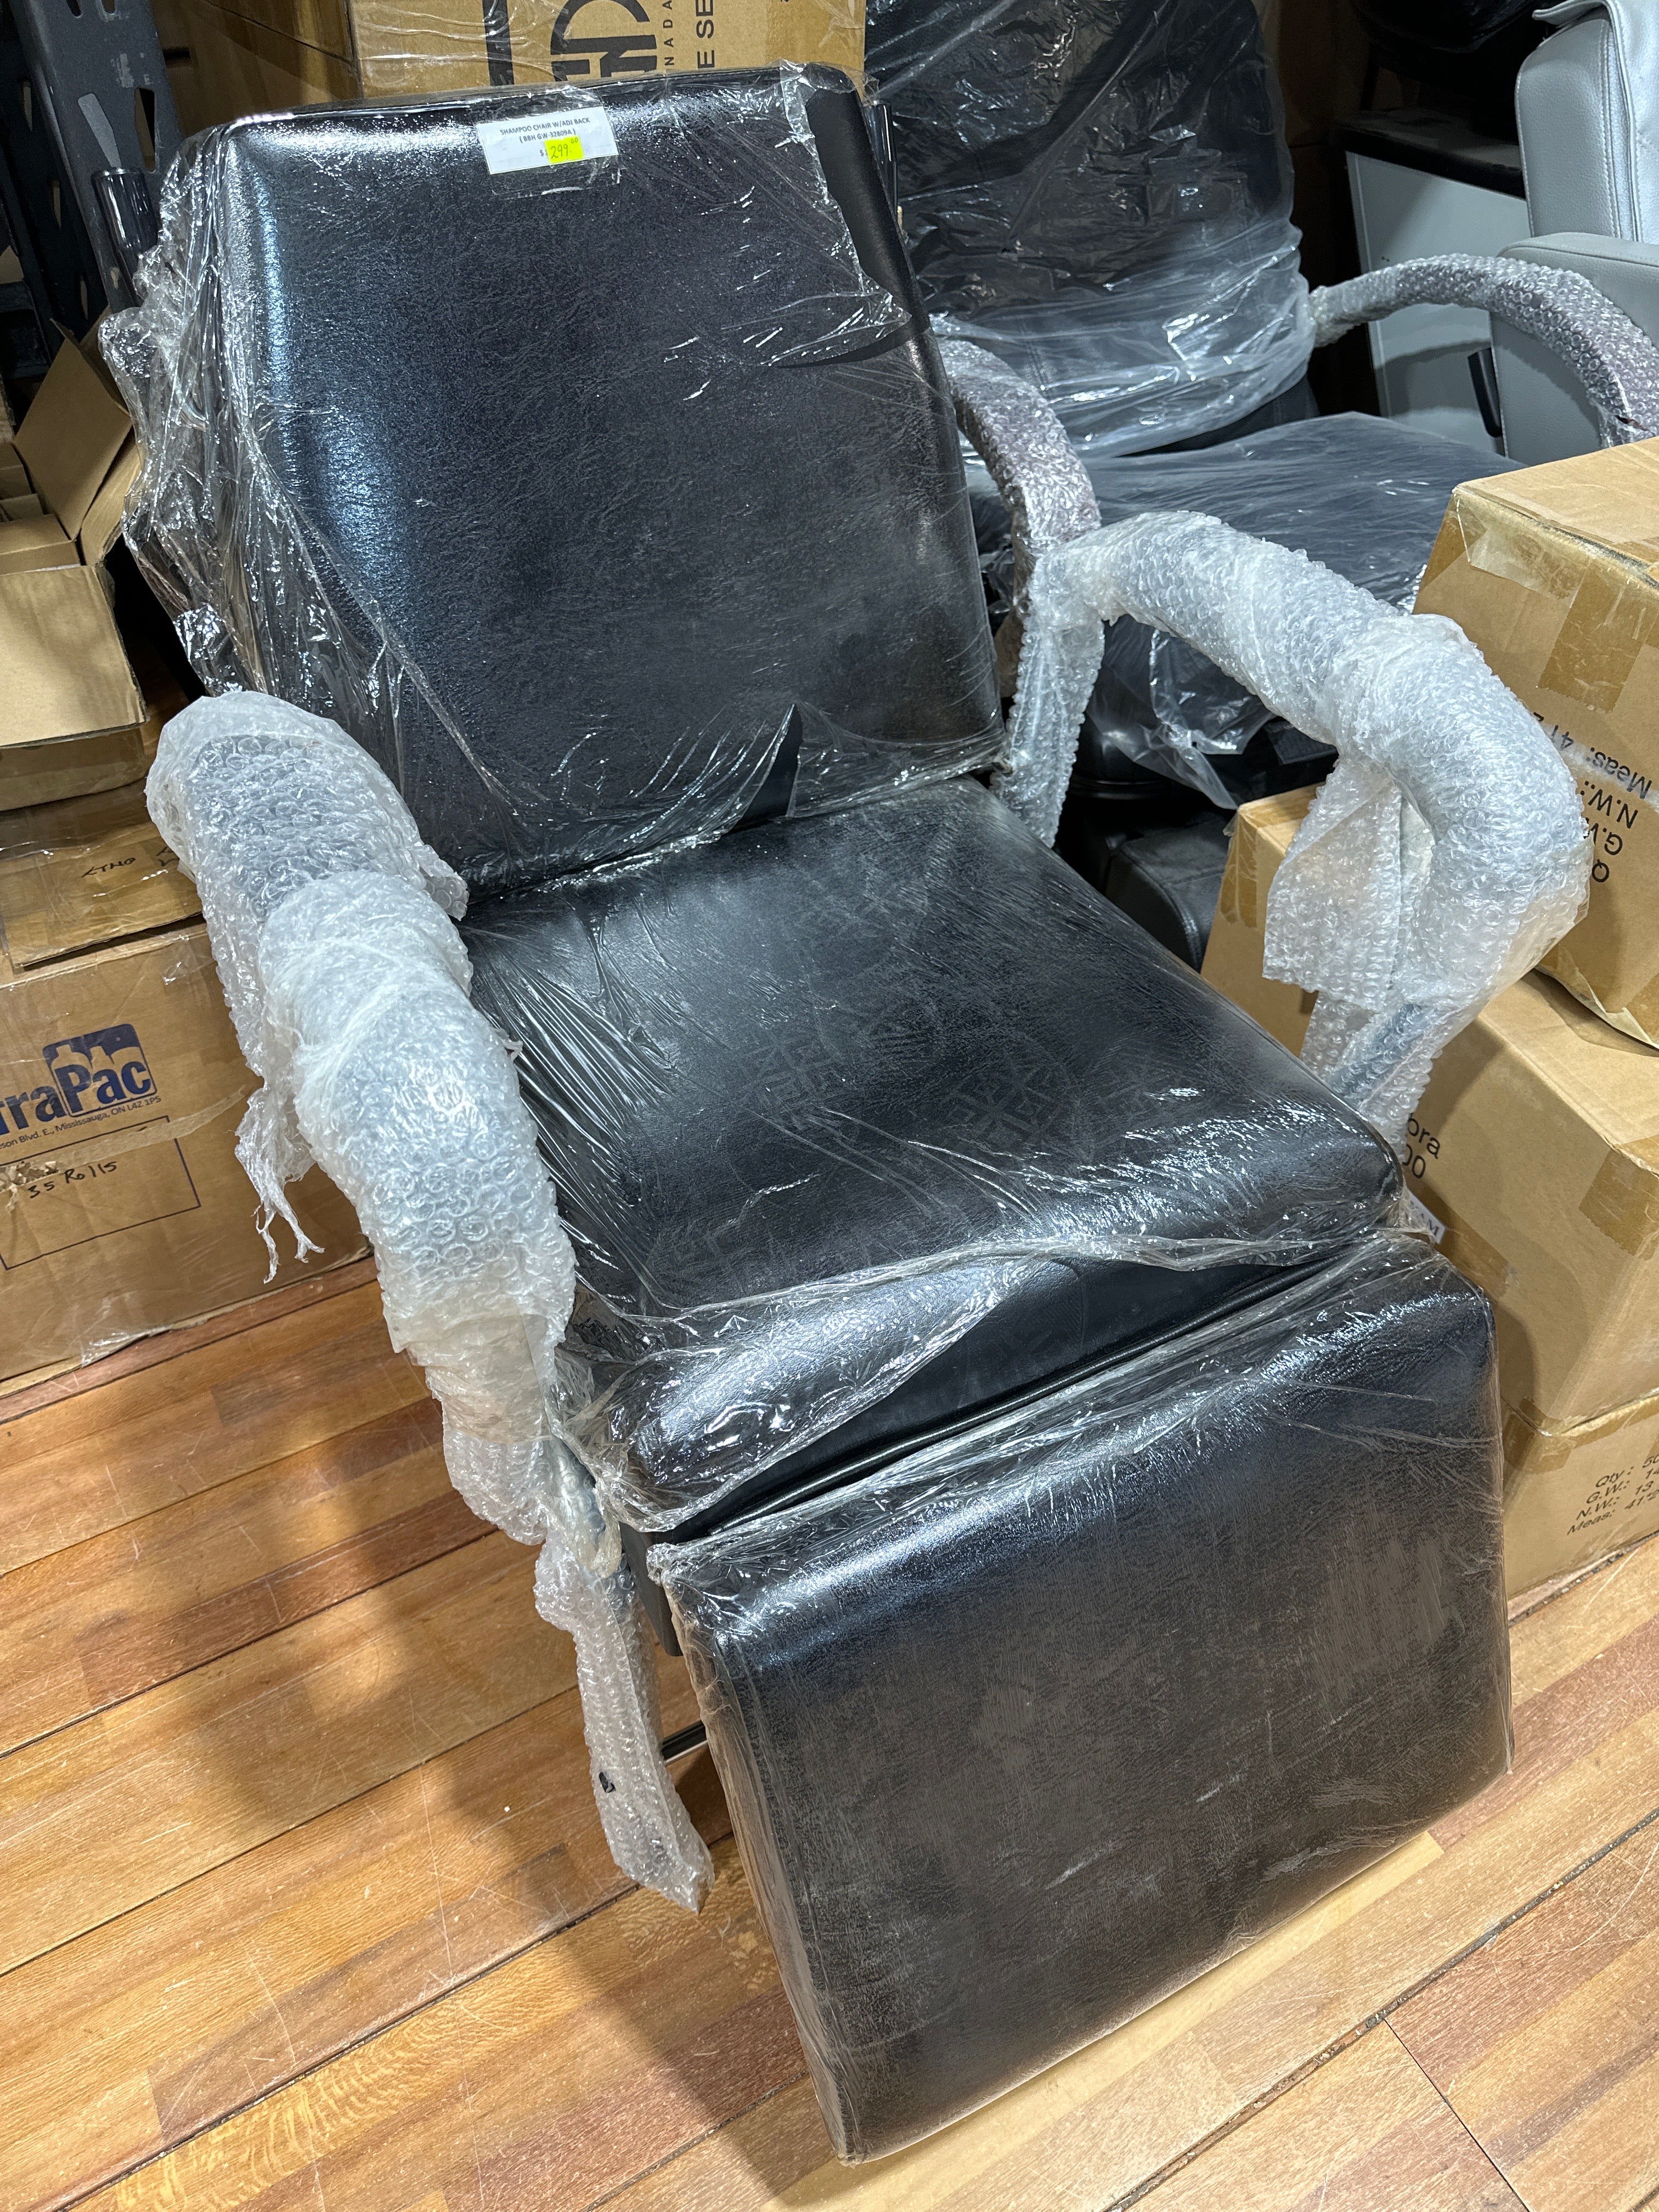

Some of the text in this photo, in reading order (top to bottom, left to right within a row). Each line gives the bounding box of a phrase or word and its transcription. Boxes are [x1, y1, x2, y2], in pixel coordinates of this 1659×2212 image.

[500, 126, 532, 136] SHAMPOO
[533, 122, 552, 131] CHAIR
[1585, 747, 1652, 800] Meas:
[0, 1138, 18, 1149] son
[55, 1111, 111, 1133] Mississauga,
[111, 1106, 126, 1116] ON
[1567, 1509, 1616, 1536] Meas:
